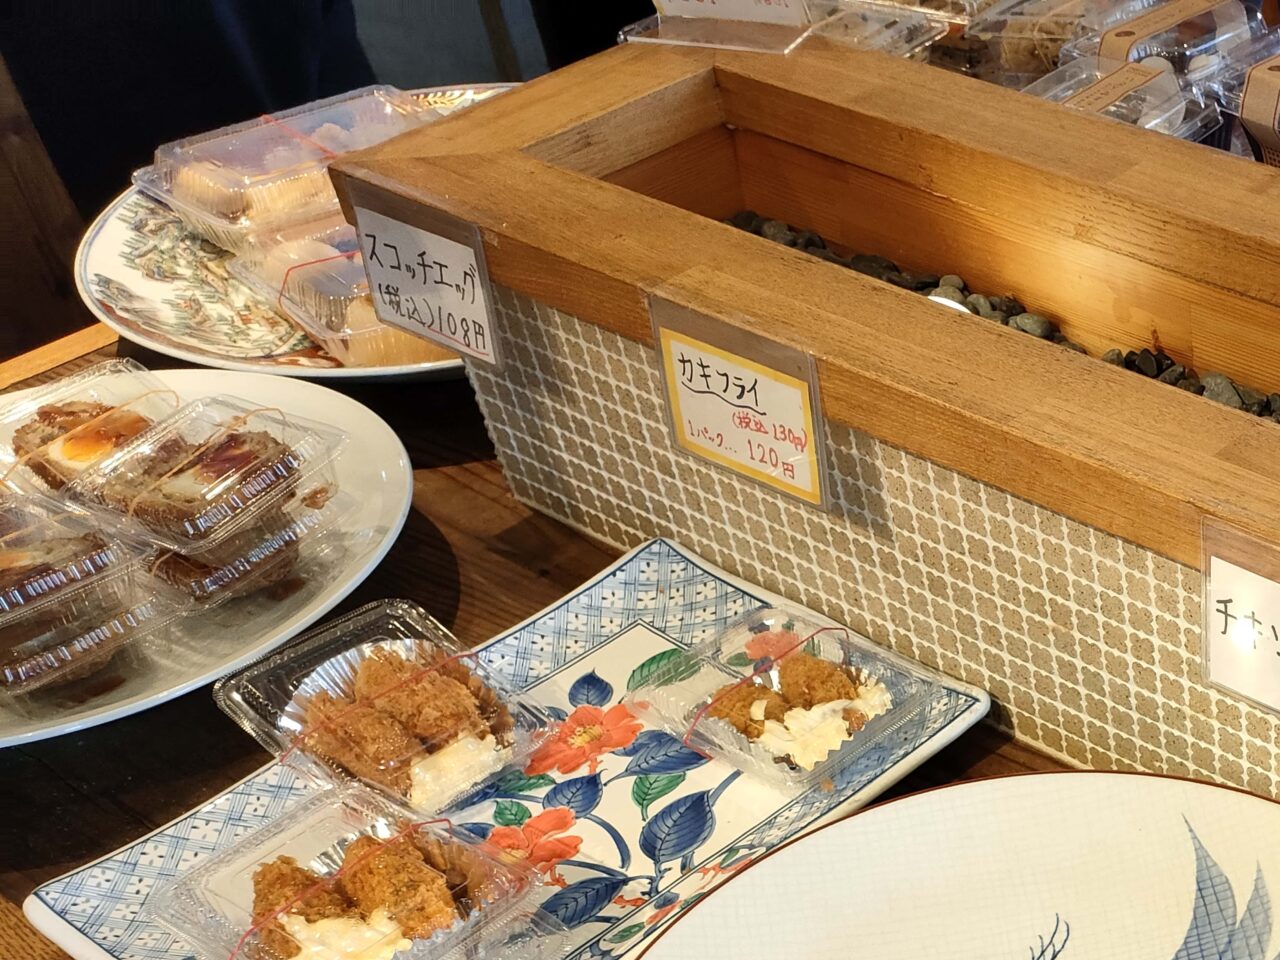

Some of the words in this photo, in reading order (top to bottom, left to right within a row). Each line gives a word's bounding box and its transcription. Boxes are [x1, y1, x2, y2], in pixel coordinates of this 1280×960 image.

[365, 233, 476, 304] スコッチエッグ
[677, 352, 760, 407] カキフライ
